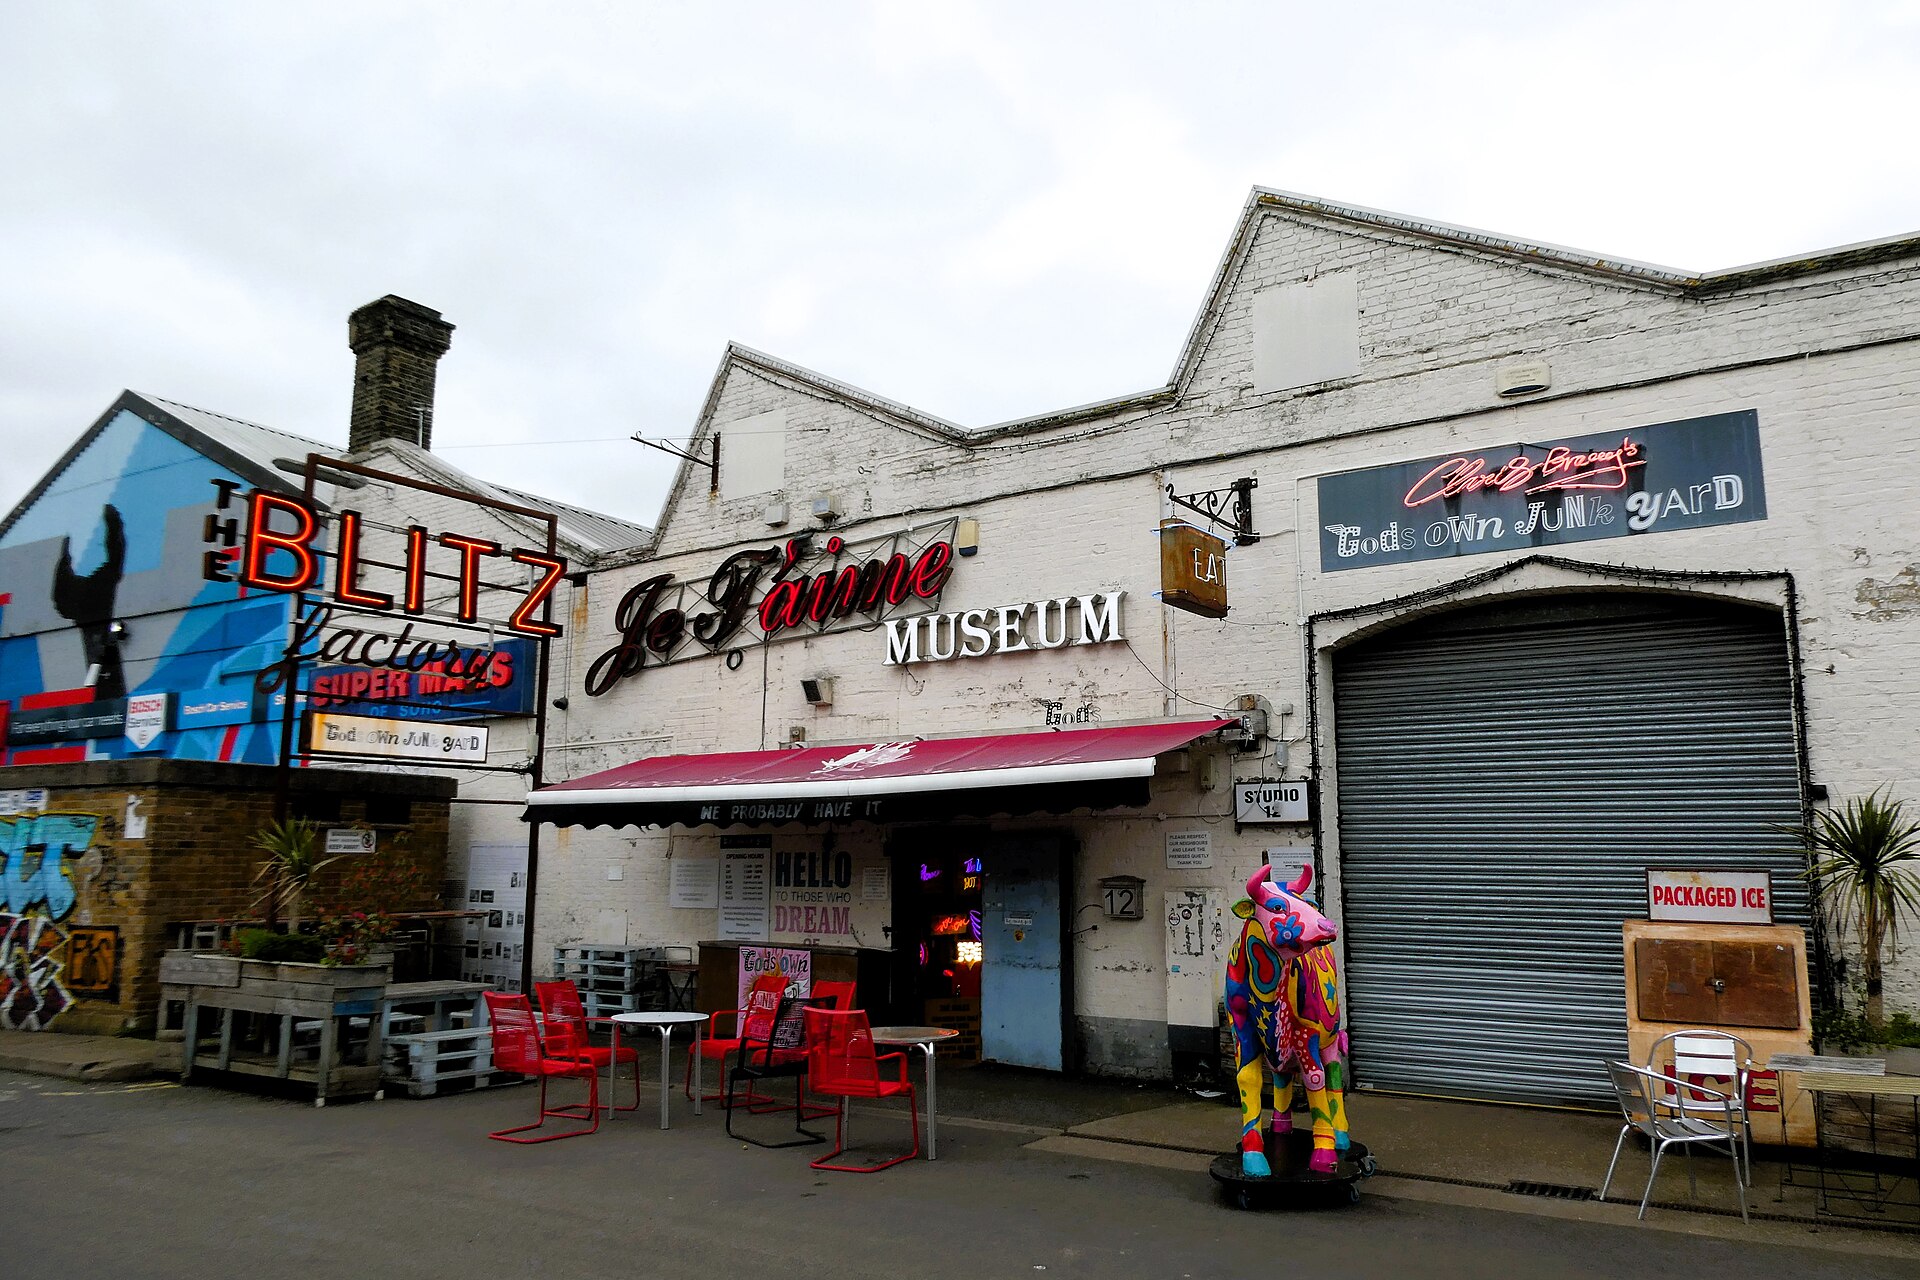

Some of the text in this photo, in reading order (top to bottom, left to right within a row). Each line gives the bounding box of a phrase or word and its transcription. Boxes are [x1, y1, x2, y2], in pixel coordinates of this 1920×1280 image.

[204, 478, 241, 583] THE
[243, 488, 568, 638] BLITZ
[881, 590, 1129, 666] MUSEUM
[312, 668, 410, 707] SUPER
[700, 801, 883, 820] WE PROBABLY HAVE IT
[1244, 788, 1299, 804] STUDIO
[775, 850, 852, 889] HELLO
[775, 891, 852, 903] TO THOSE WHO
[1104, 889, 1134, 915] 12
[1653, 885, 1766, 909] PACKAGED ICE
[774, 905, 851, 935] DREAM
